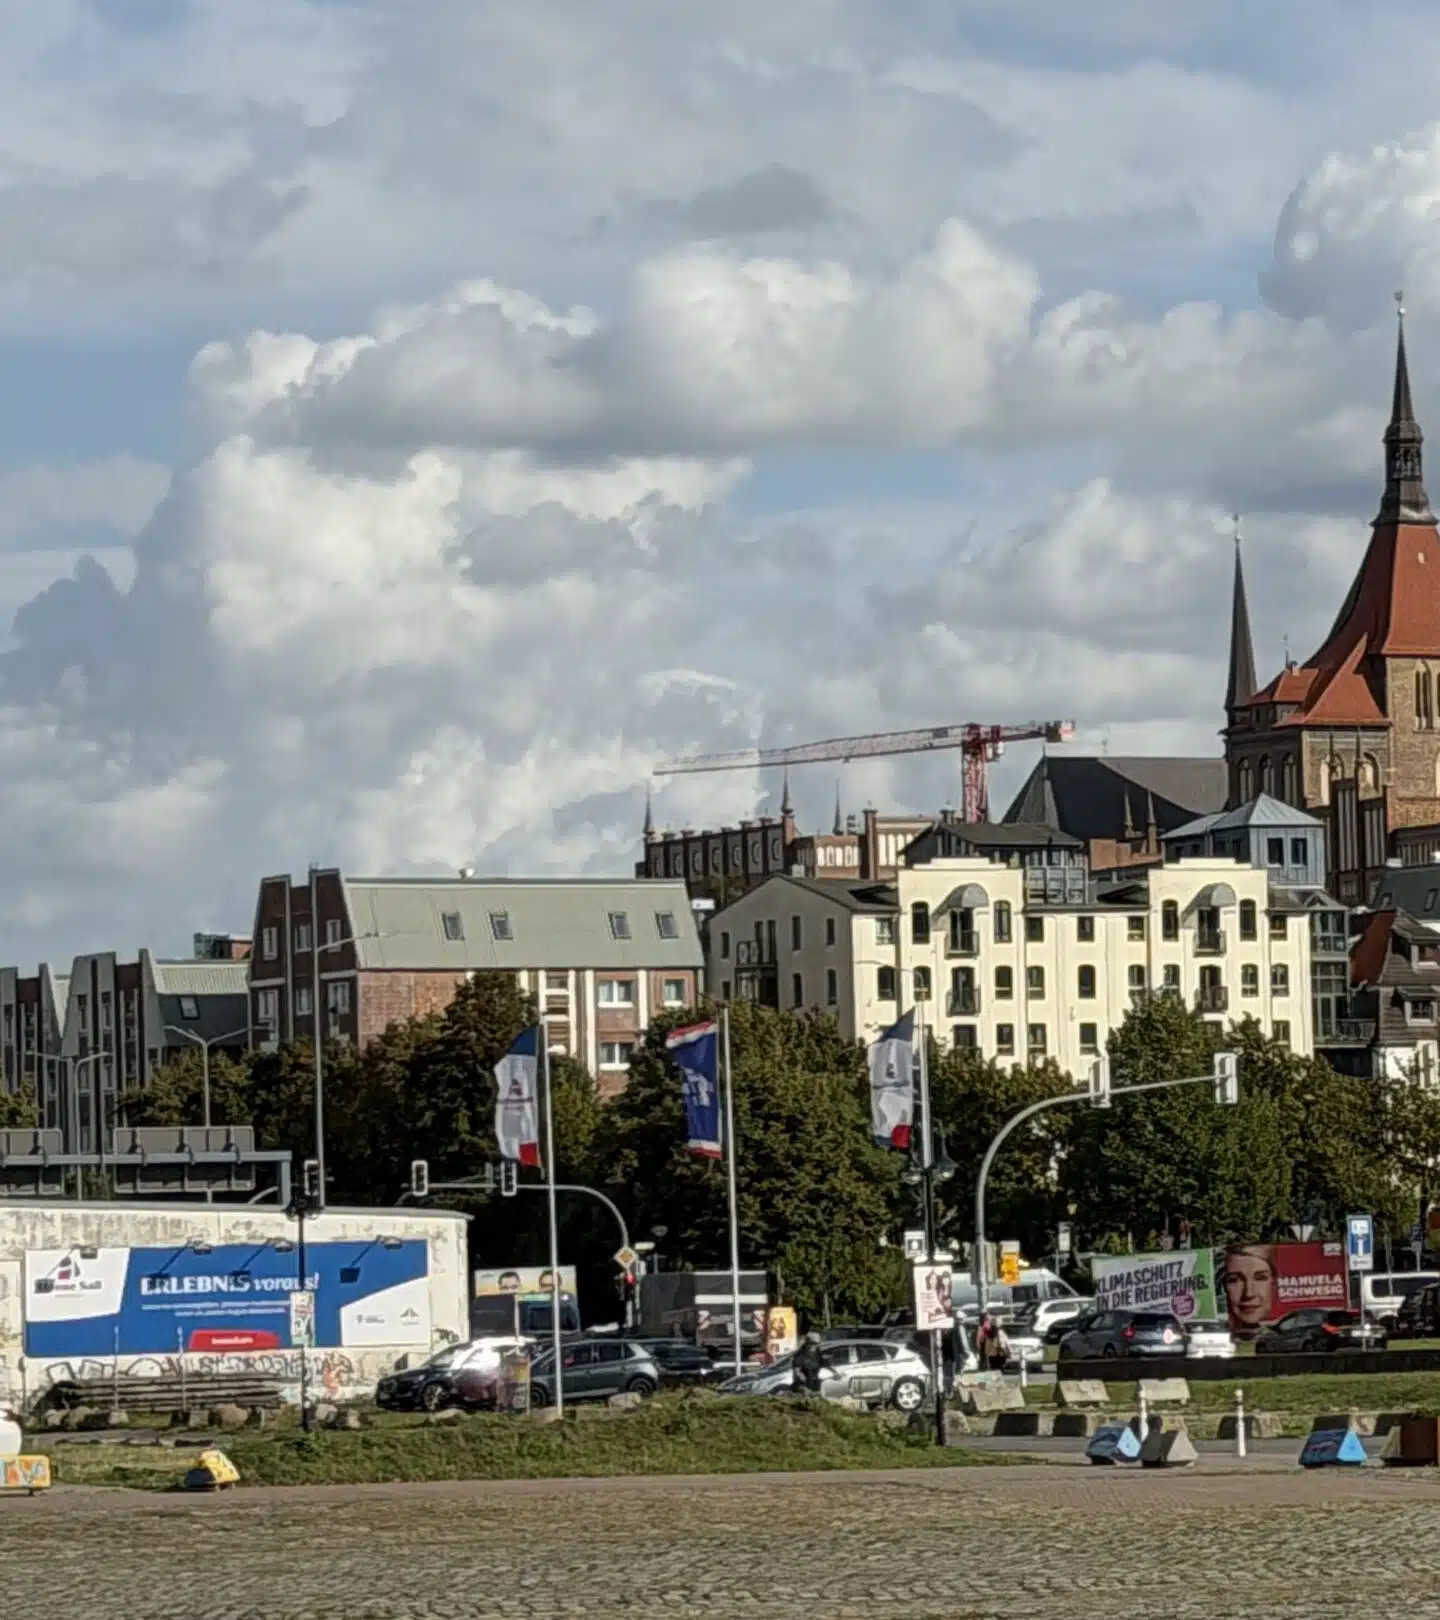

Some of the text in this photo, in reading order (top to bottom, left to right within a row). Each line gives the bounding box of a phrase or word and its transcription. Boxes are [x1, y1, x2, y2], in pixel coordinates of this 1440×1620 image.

[140, 1275, 250, 1296] ERLEBNIS
[1098, 1261, 1185, 1294] KLIMASCHUTZ
[1277, 1273, 1343, 1287] MANUELA
[1112, 1289, 1133, 1308] DIE
[1277, 1284, 1344, 1298] SCHWESIG
